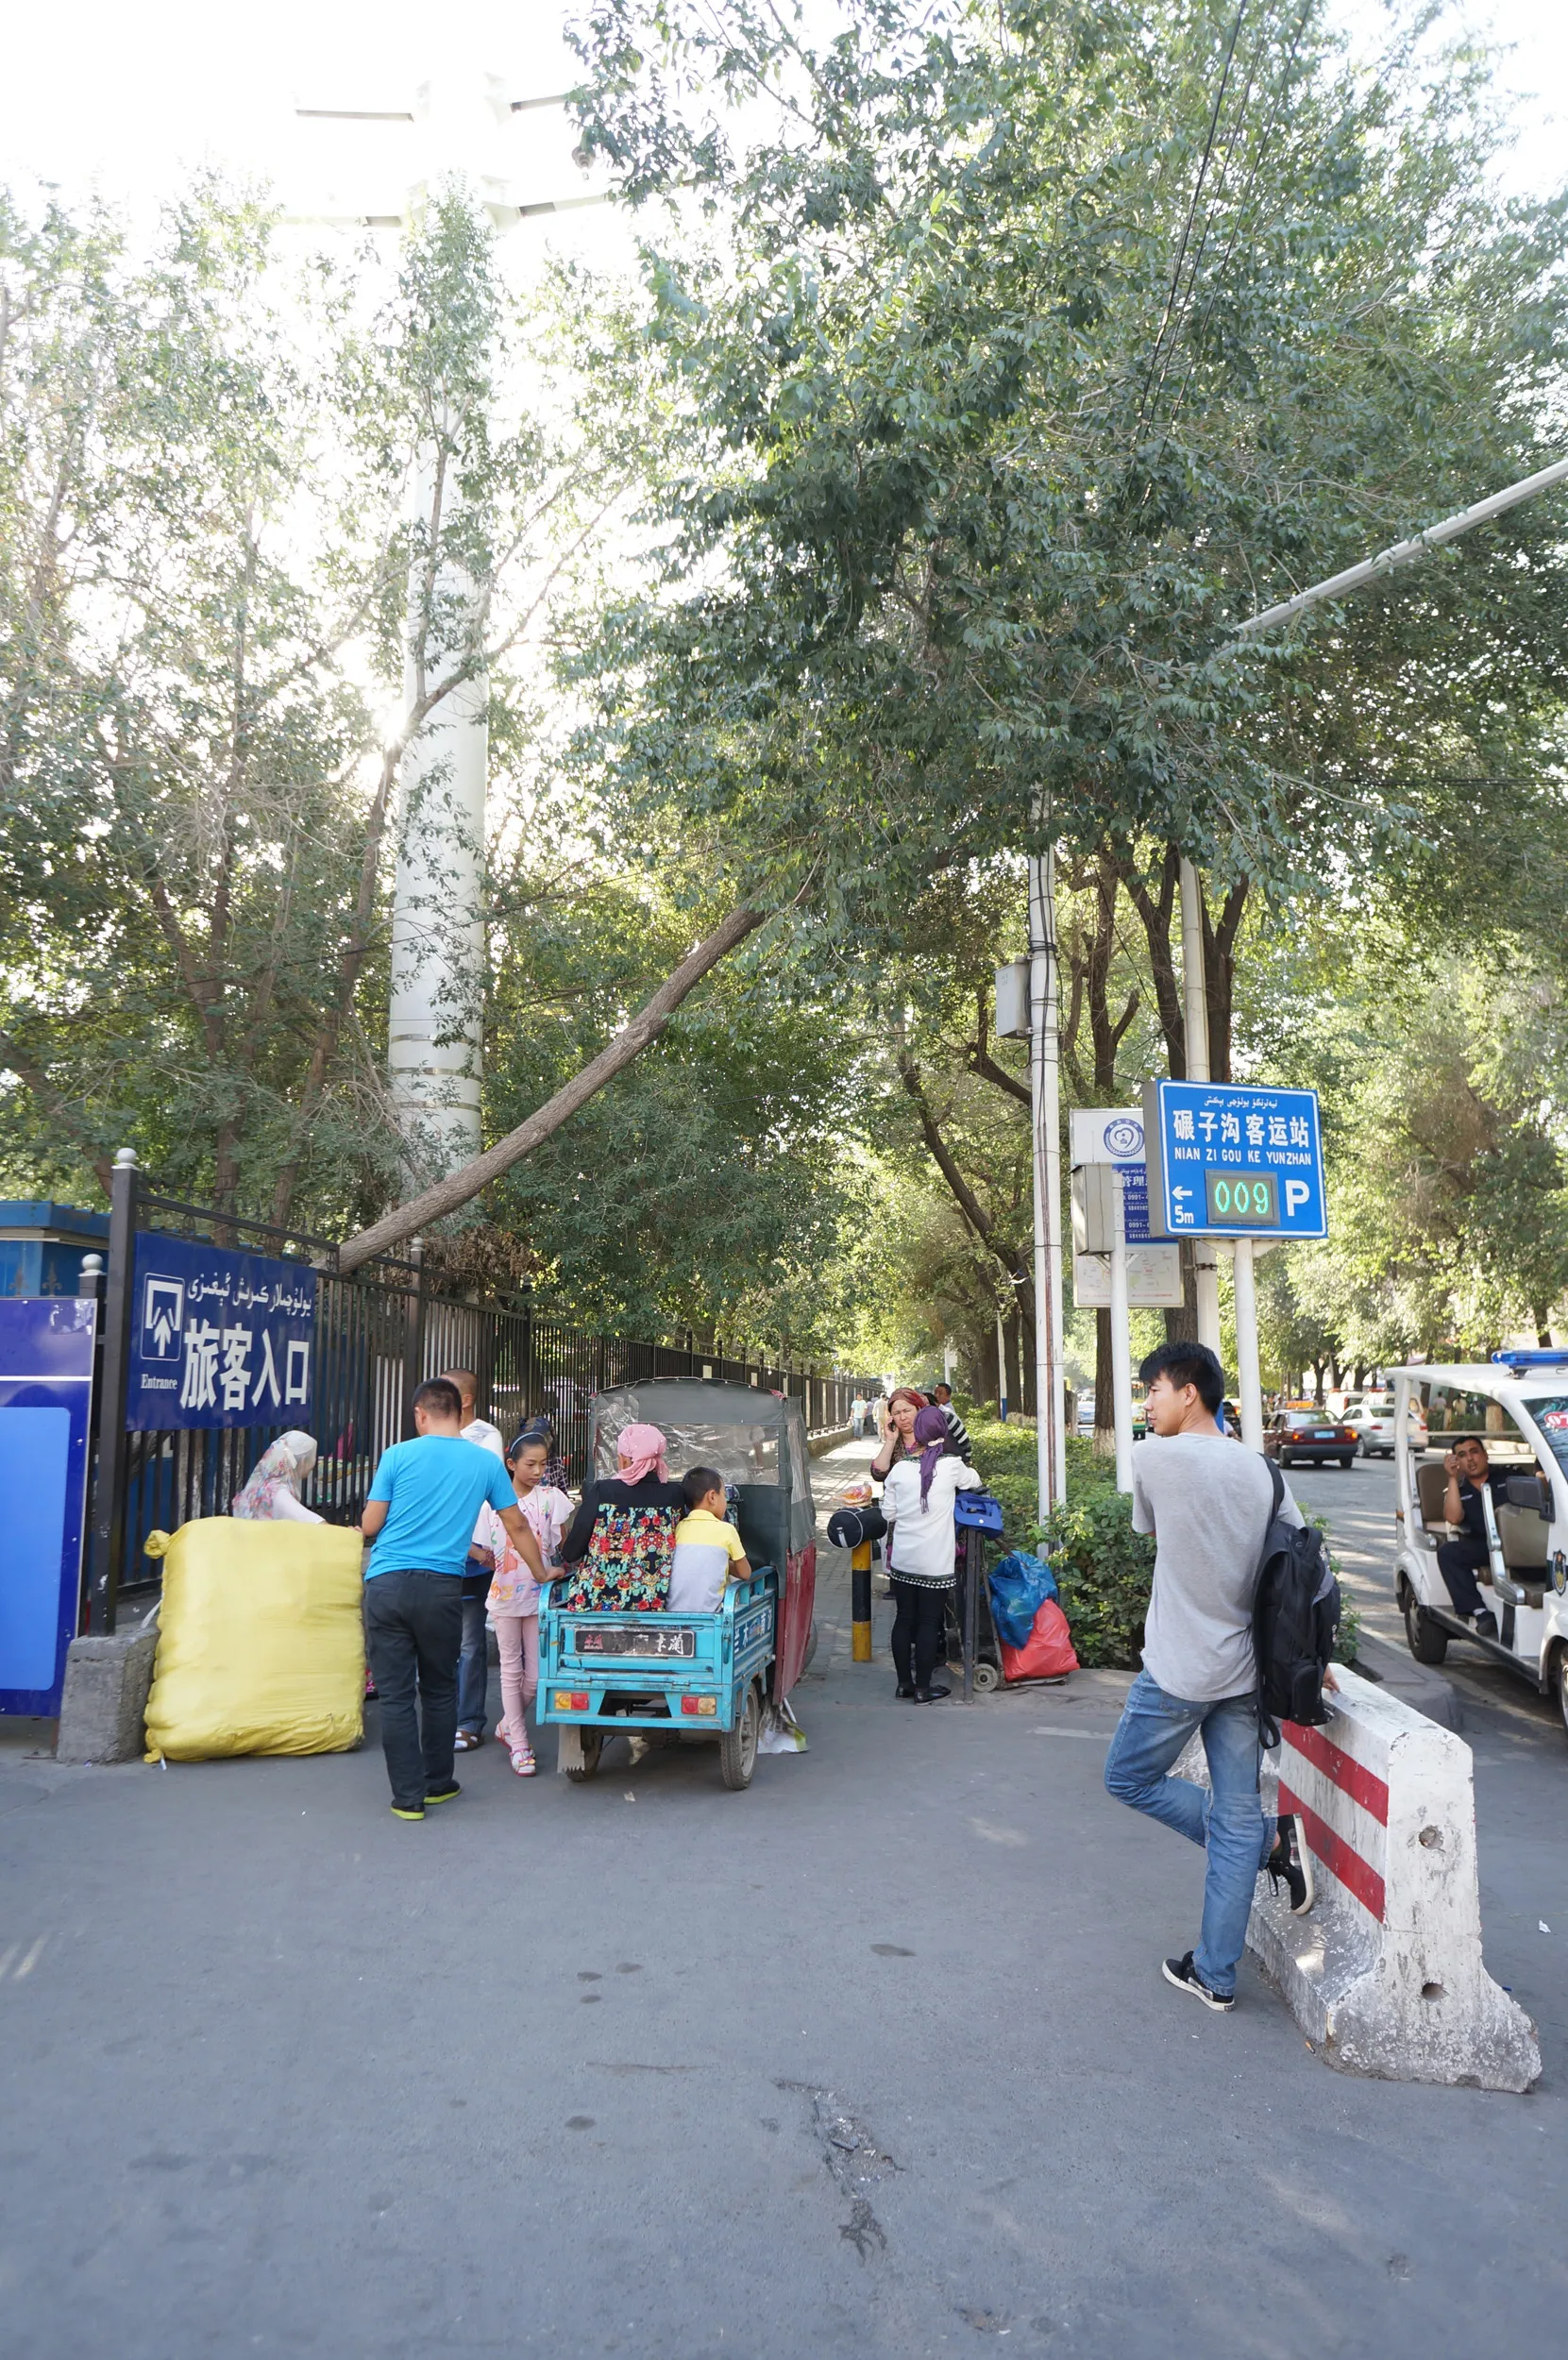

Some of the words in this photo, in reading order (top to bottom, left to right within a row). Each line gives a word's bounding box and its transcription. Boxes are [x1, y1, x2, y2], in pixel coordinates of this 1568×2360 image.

[1172, 1109, 1309, 1149] 碾子沟客运站
[1173, 1147, 1201, 1161] NIAN
[1206, 1148, 1217, 1162] ZI
[1221, 1149, 1242, 1163] GOU
[1247, 1150, 1261, 1164] KE
[1266, 1151, 1312, 1166] YUNZHAN
[1214, 1180, 1270, 1215] 009
[1285, 1179, 1310, 1217] P
[1174, 1205, 1194, 1225] 5m
[231, 1277, 269, 1310] كىرىش
[179, 1318, 311, 1411] 旅客入口
[140, 1374, 178, 1391] Entrance
